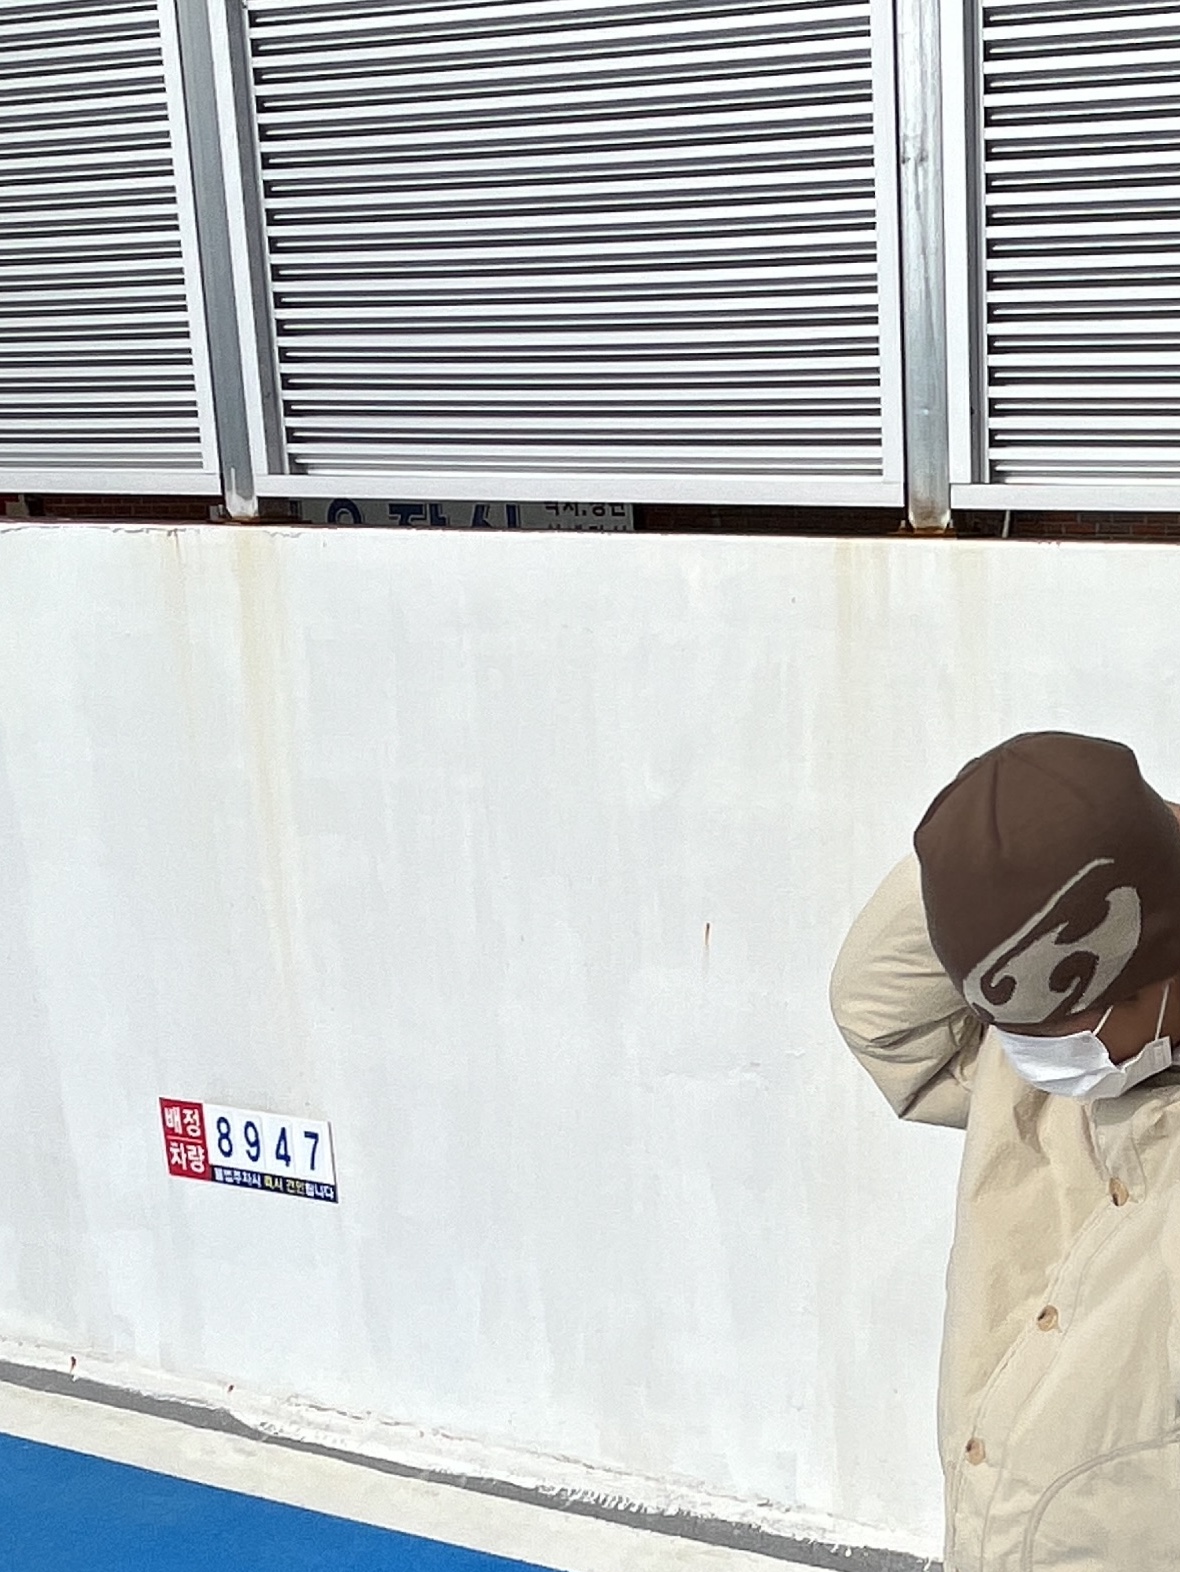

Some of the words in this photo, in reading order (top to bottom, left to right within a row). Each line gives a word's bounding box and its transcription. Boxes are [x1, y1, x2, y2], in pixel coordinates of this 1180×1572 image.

[163, 1106, 202, 1137] 배정
[169, 1141, 205, 1173] 차량
[216, 1116, 319, 1171] 8947
